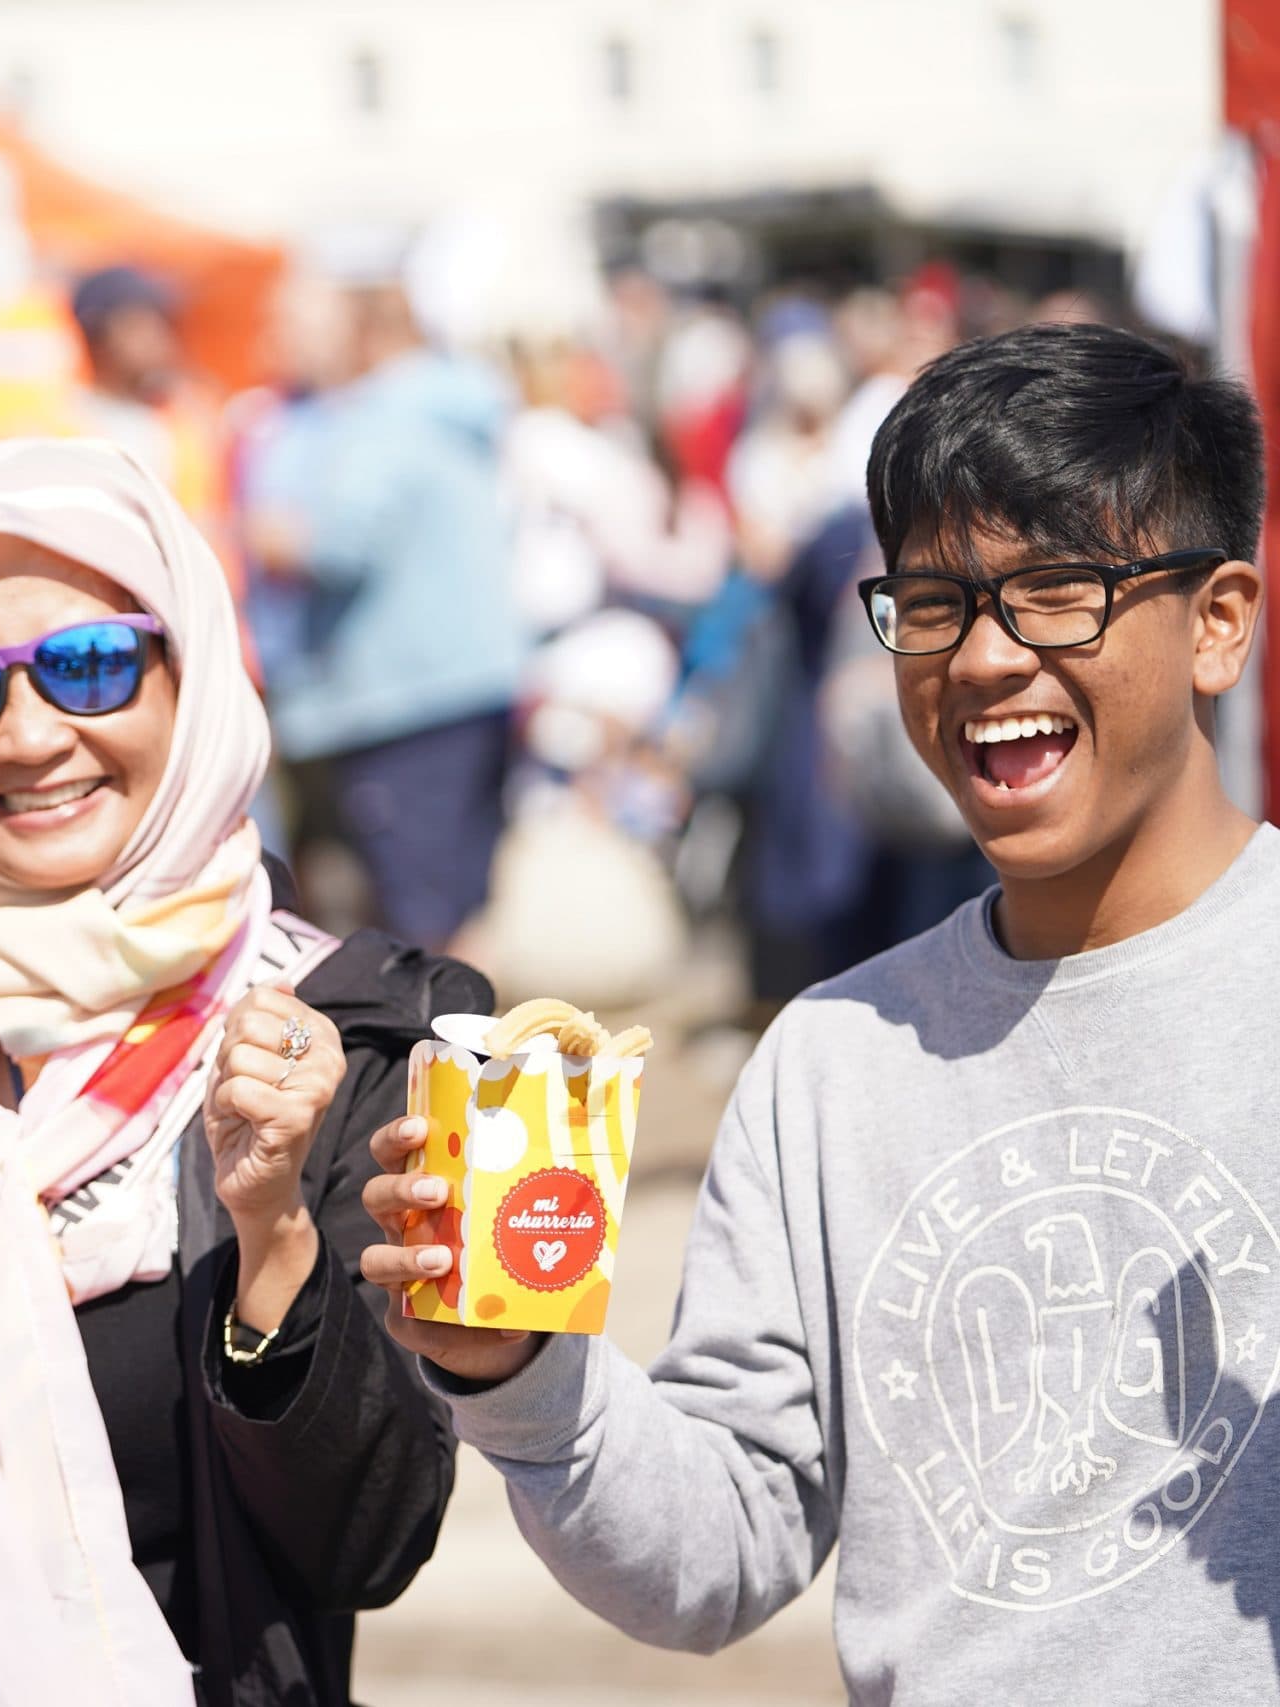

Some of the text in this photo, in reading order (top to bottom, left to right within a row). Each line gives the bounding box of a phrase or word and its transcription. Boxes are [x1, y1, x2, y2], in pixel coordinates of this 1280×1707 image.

[508, 1209, 595, 1229] churrería
[533, 1196, 559, 1211] mi
[879, 1128, 1271, 1321] LIVE & LET FLY
[987, 1544, 1051, 1595] IS
[1085, 1417, 1232, 1577] GOOD
